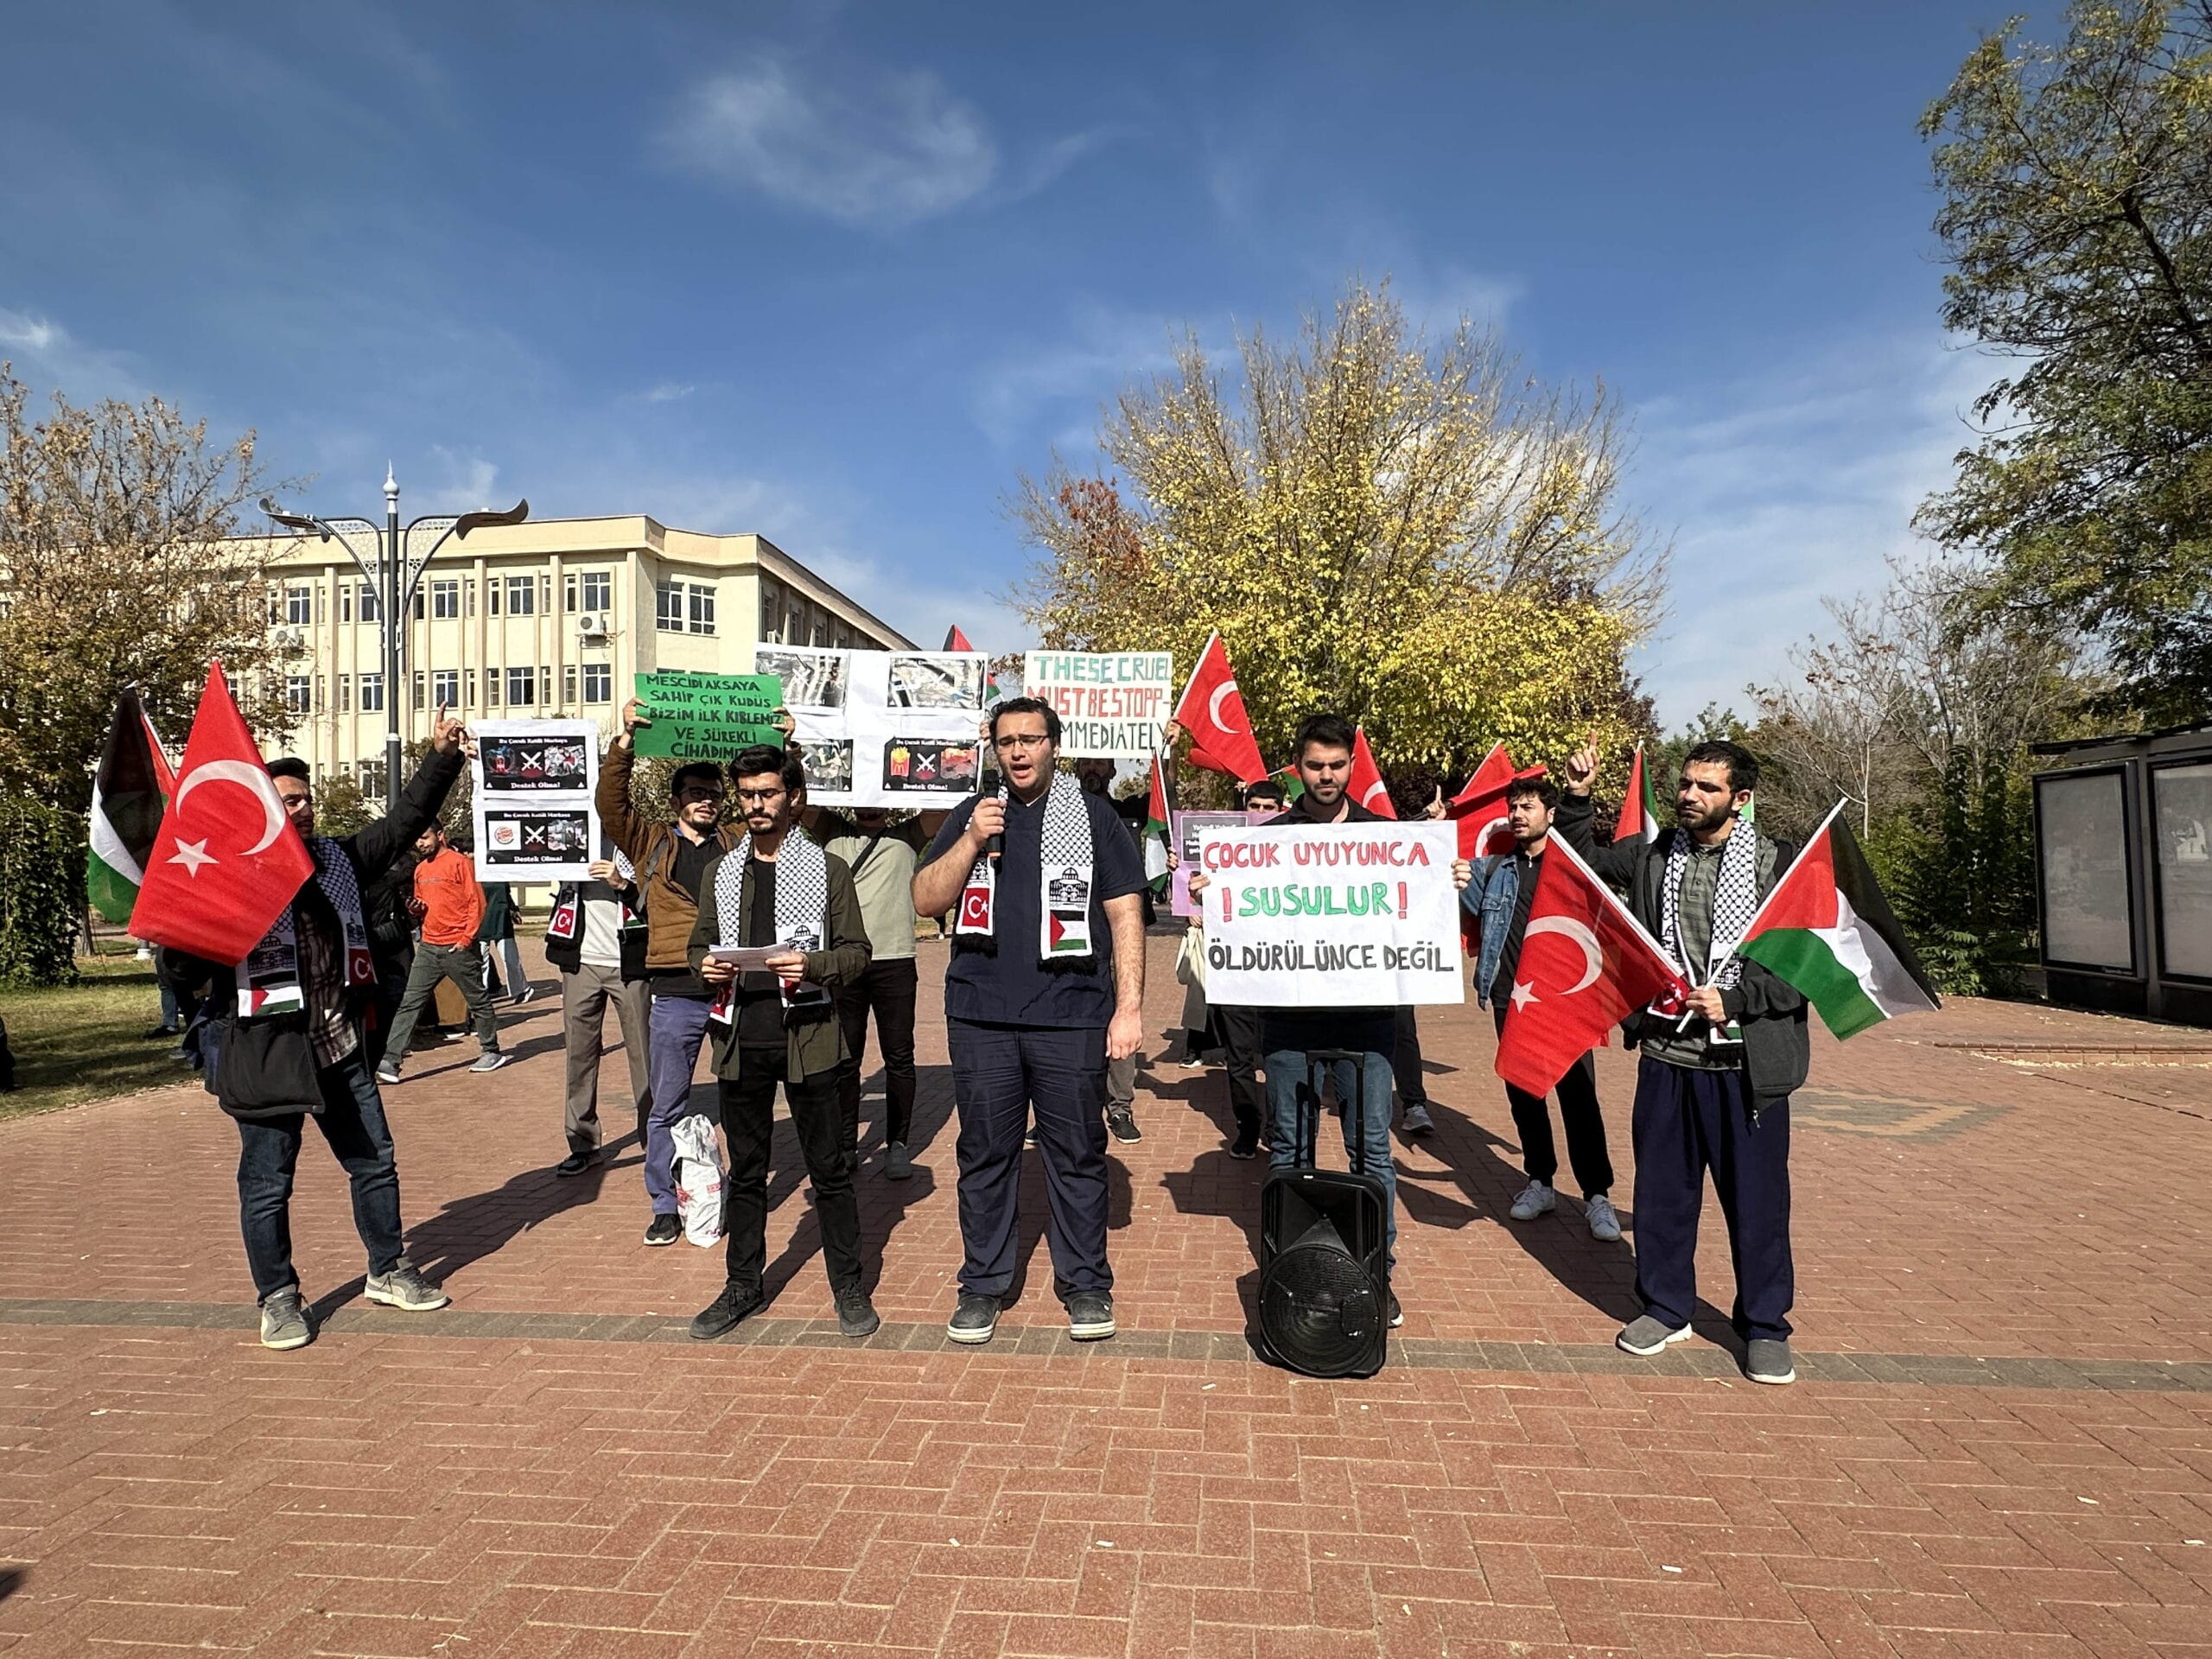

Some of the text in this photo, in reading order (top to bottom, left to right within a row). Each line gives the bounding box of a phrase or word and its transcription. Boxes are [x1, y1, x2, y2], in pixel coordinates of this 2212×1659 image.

[1033, 656, 1171, 683] THESE CRUEL
[705, 679, 760, 691] AKSAYA
[699, 694, 722, 706] ÇIK
[1087, 688, 1109, 717] BE
[649, 707, 694, 721] BİZİM
[697, 708, 722, 722] İLK
[674, 727, 757, 743] VE SÜREKLİ
[671, 741, 743, 759] CİHADIMI
[1204, 841, 1430, 874] ÇOCUK UYUYUNCA
[1208, 938, 1454, 972] ÖLDÜRÜLÜNCE DEĞİL
